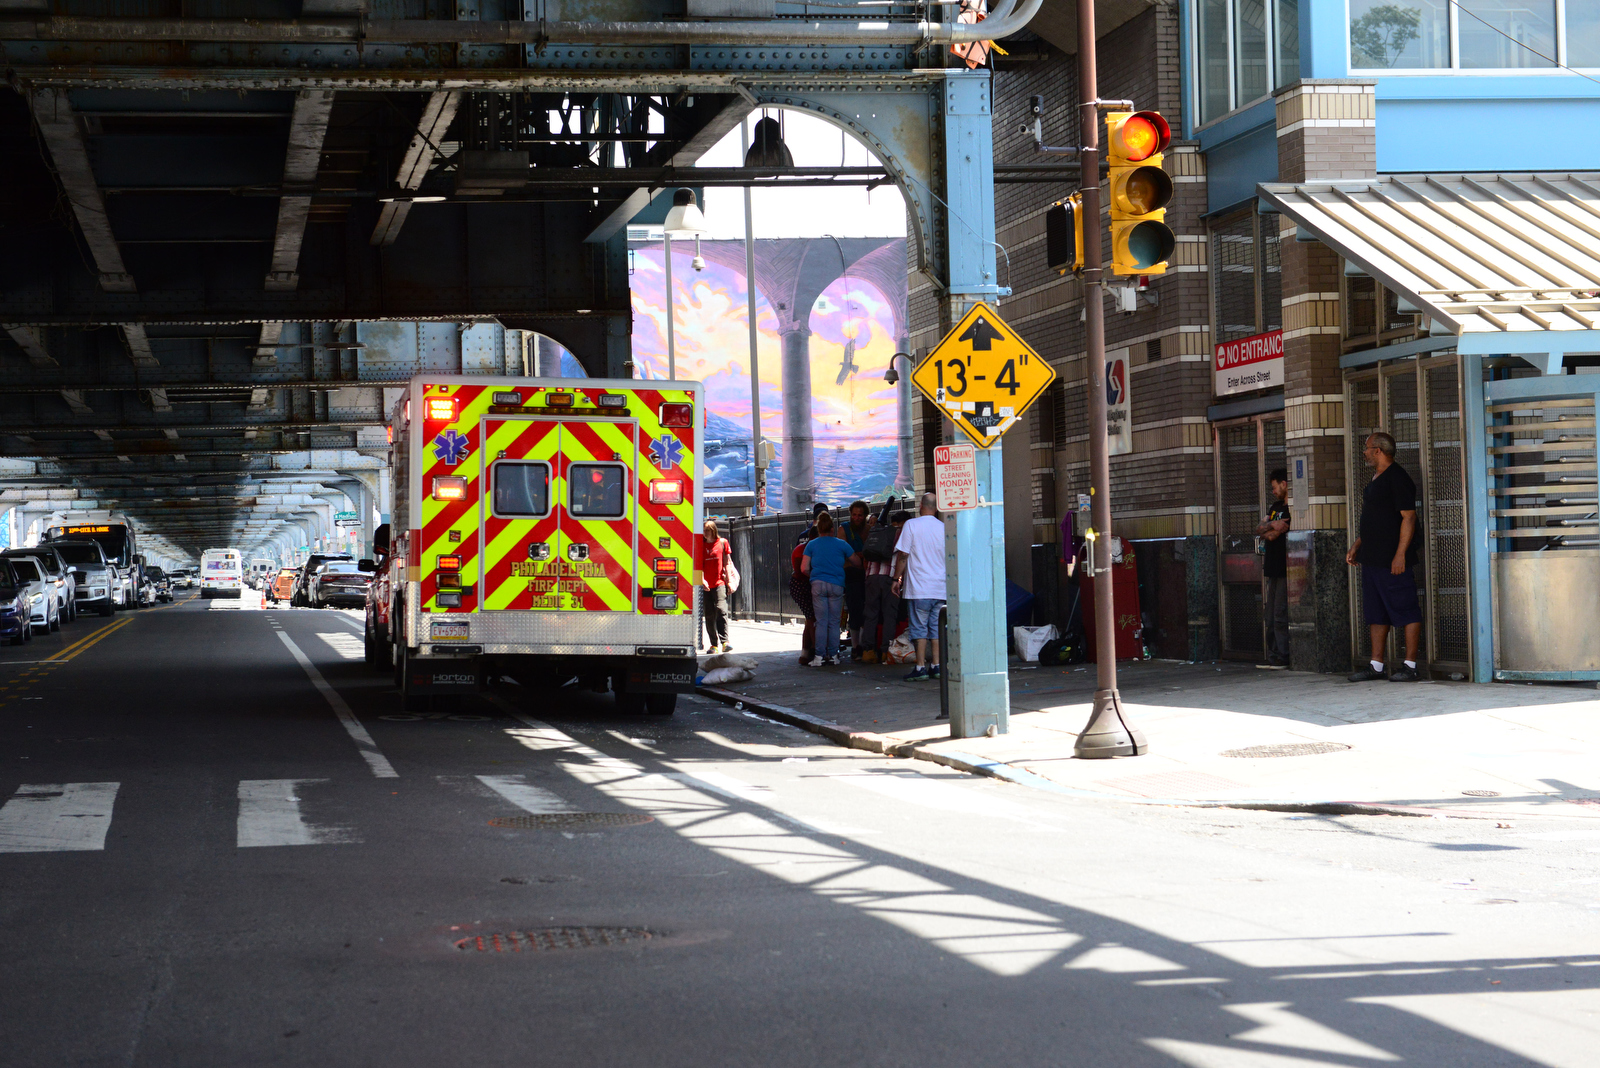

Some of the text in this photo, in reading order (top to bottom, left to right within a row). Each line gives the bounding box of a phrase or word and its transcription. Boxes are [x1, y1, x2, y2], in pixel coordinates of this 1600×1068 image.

[1226, 334, 1284, 365] NO ENTRANC
[1227, 370, 1271, 388] Enter Across Street
[936, 449, 972, 462] NO PARKING
[944, 464, 966, 472] STREET
[940, 471, 971, 479] CLEANING
[939, 478, 973, 488] MONDAY
[511, 562, 607, 578] PHILADELPHIA
[528, 580, 589, 593] FIRE DEPT.
[532, 595, 584, 608] MEDIC 31
[650, 672, 691, 680] Horton
